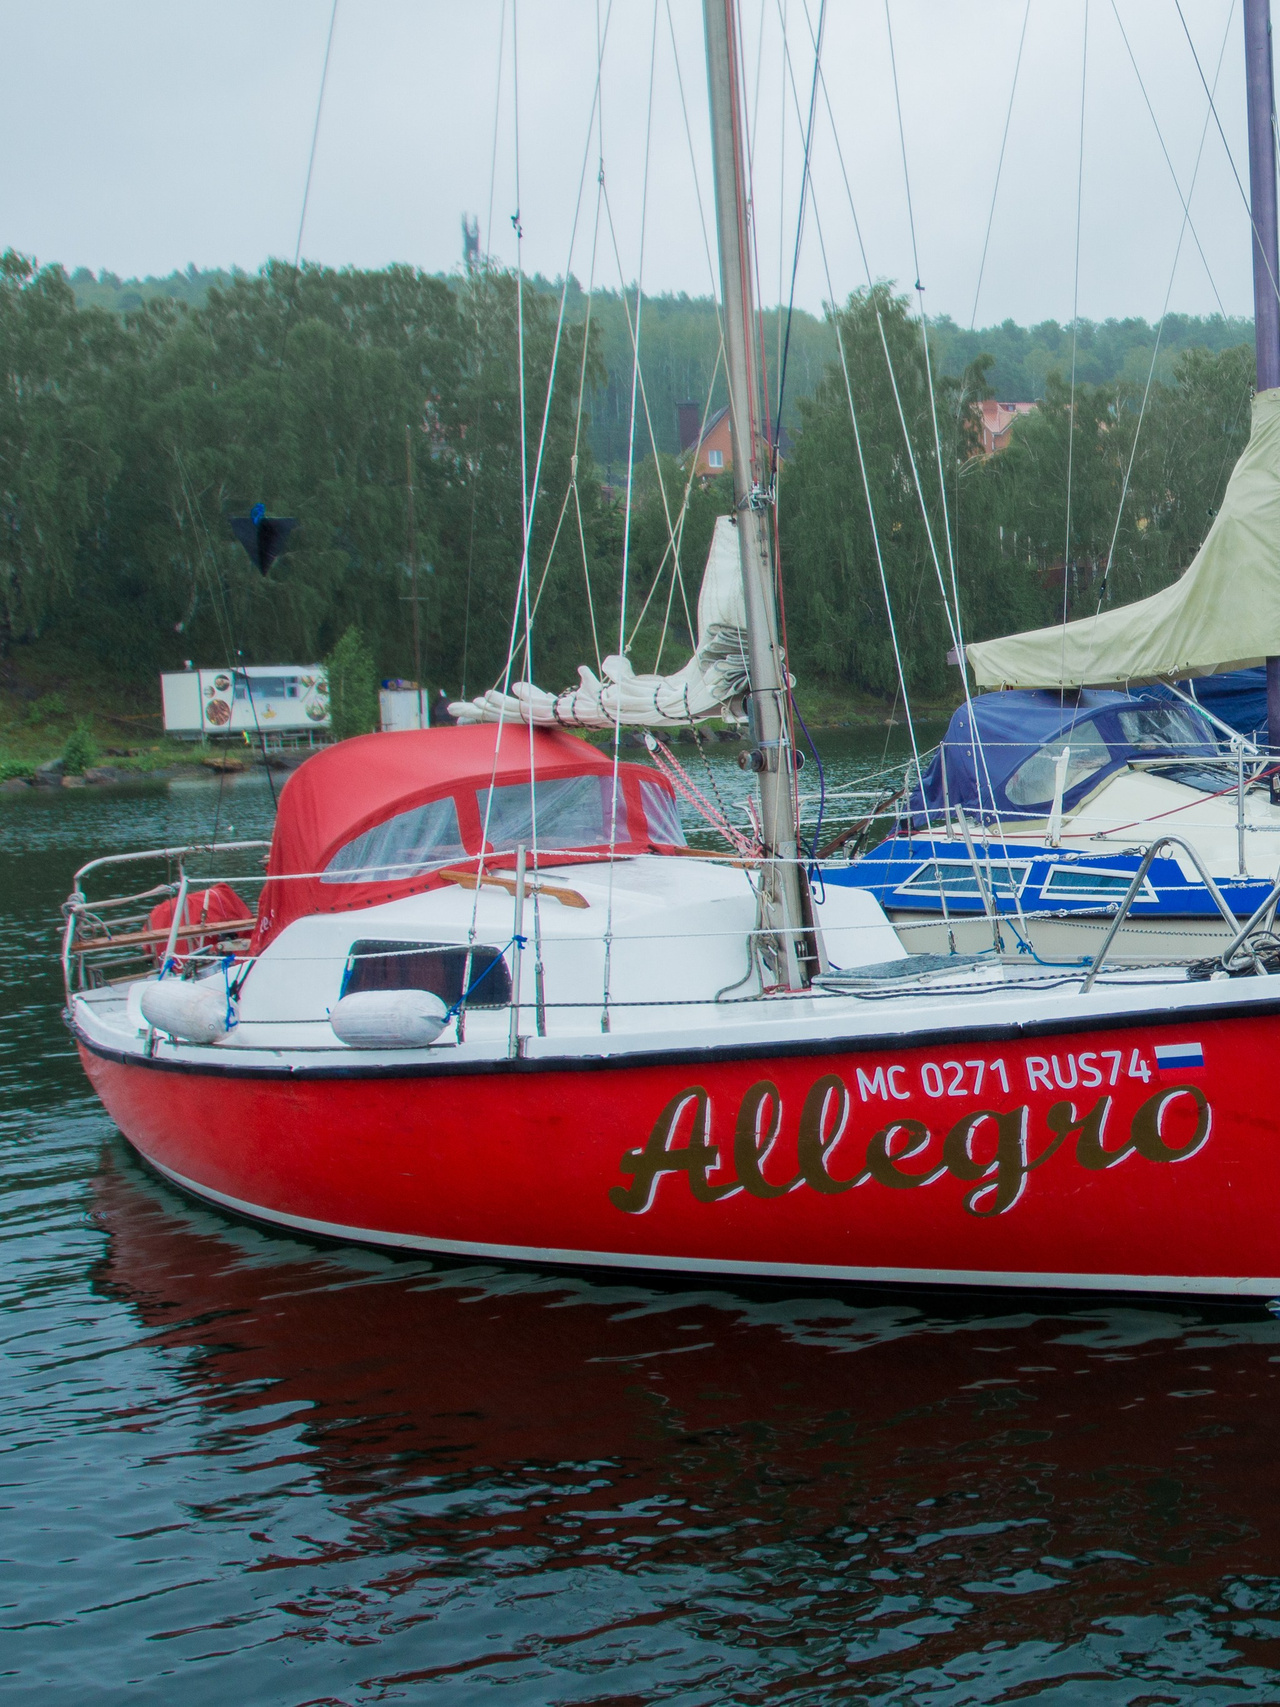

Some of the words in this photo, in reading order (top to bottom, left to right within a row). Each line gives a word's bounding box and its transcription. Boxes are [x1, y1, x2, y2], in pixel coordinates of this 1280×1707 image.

[855, 1065, 911, 1102] MC
[921, 1058, 1010, 1098] 0271
[1026, 1048, 1152, 1092] RUS74
[608, 1073, 1213, 1218] Allegro
